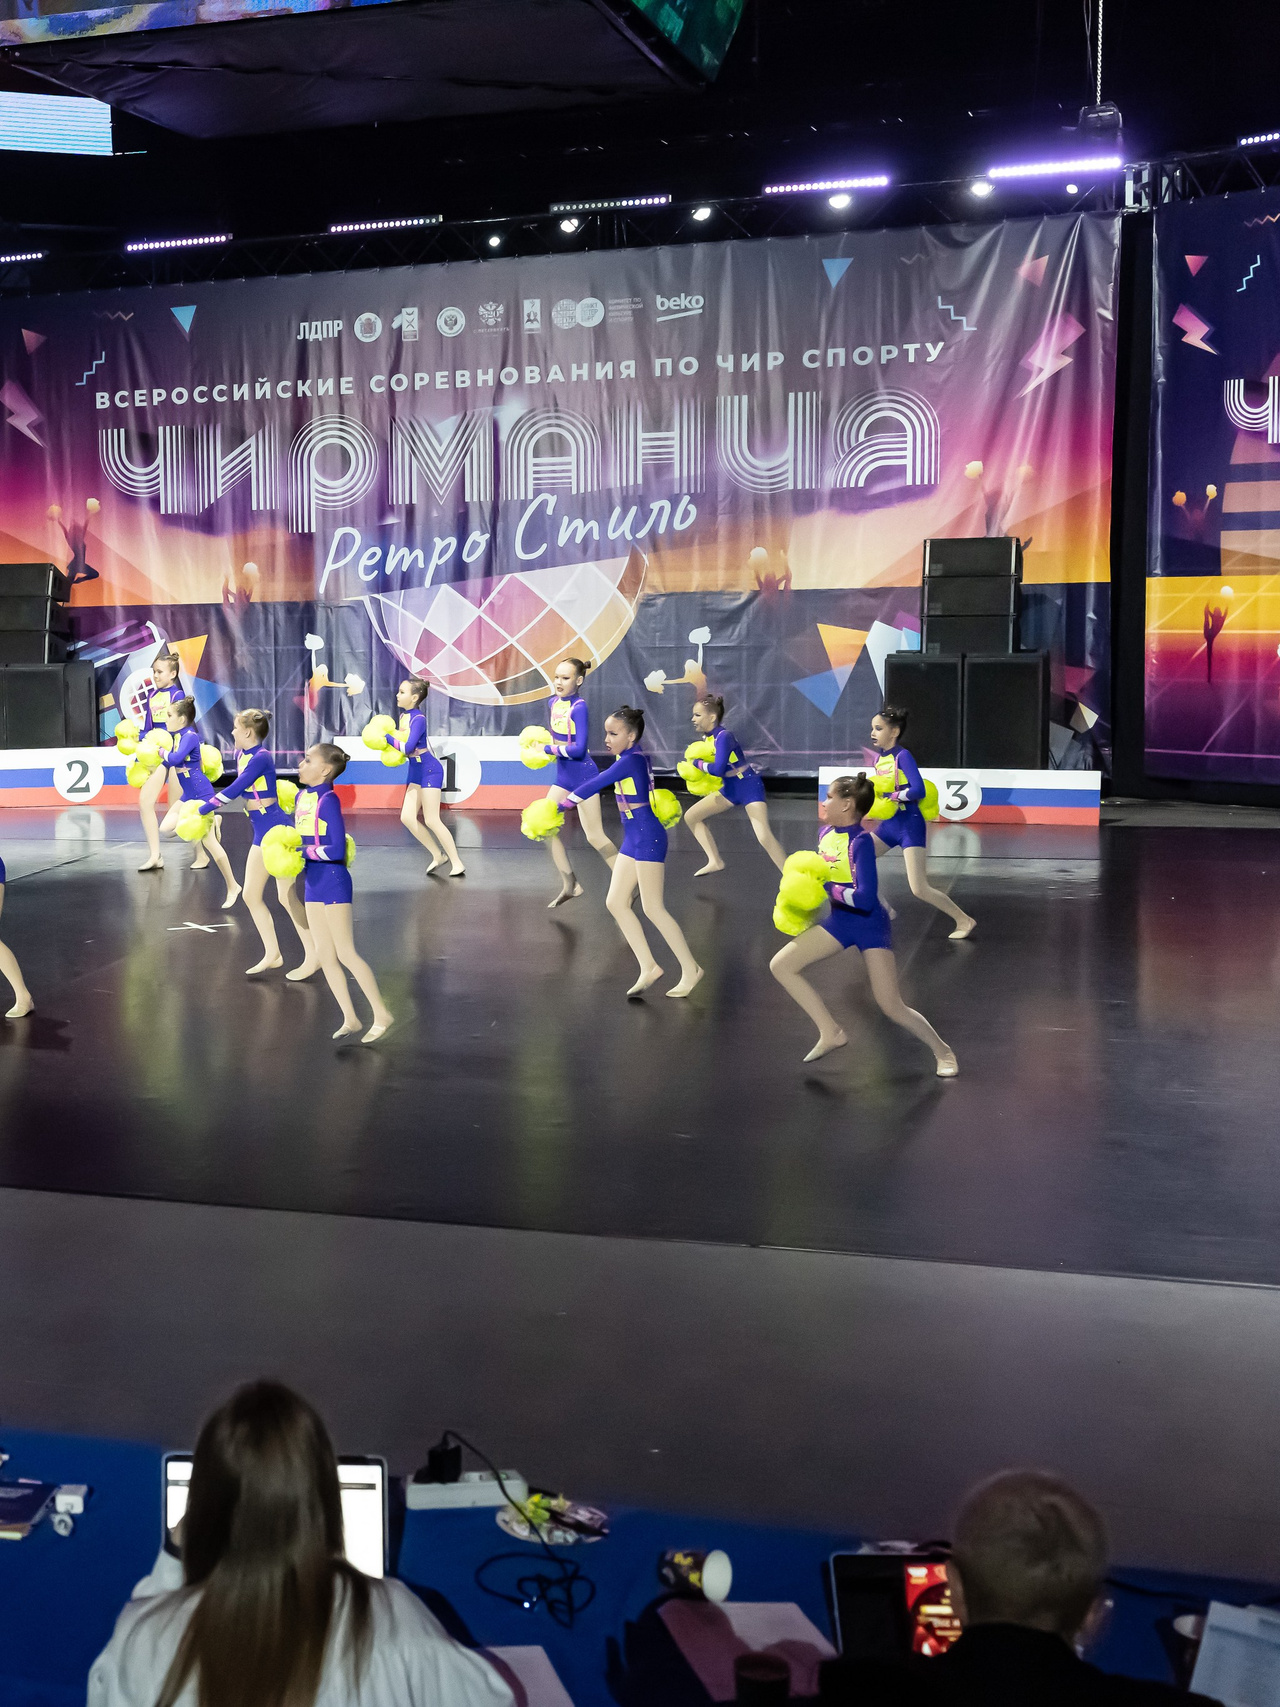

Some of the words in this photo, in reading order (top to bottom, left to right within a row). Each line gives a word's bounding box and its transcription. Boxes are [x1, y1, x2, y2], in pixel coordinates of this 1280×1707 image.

[656, 293, 705, 311] beko
[297, 320, 343, 341] ЛДПР
[95, 377, 354, 409] ВСЕРОССИЙСКИЕ
[369, 360, 636, 393] СОРЕВНОВАНИЯ
[654, 356, 699, 377] ПО
[716, 351, 785, 373] ЧИР
[802, 341, 945, 369] СПОРТУ
[318, 526, 491, 595] Ретро
[515, 492, 698, 560] Стиль
[66, 759, 91, 794] 2
[439, 752, 462, 792] 1
[945, 780, 969, 812] 3
